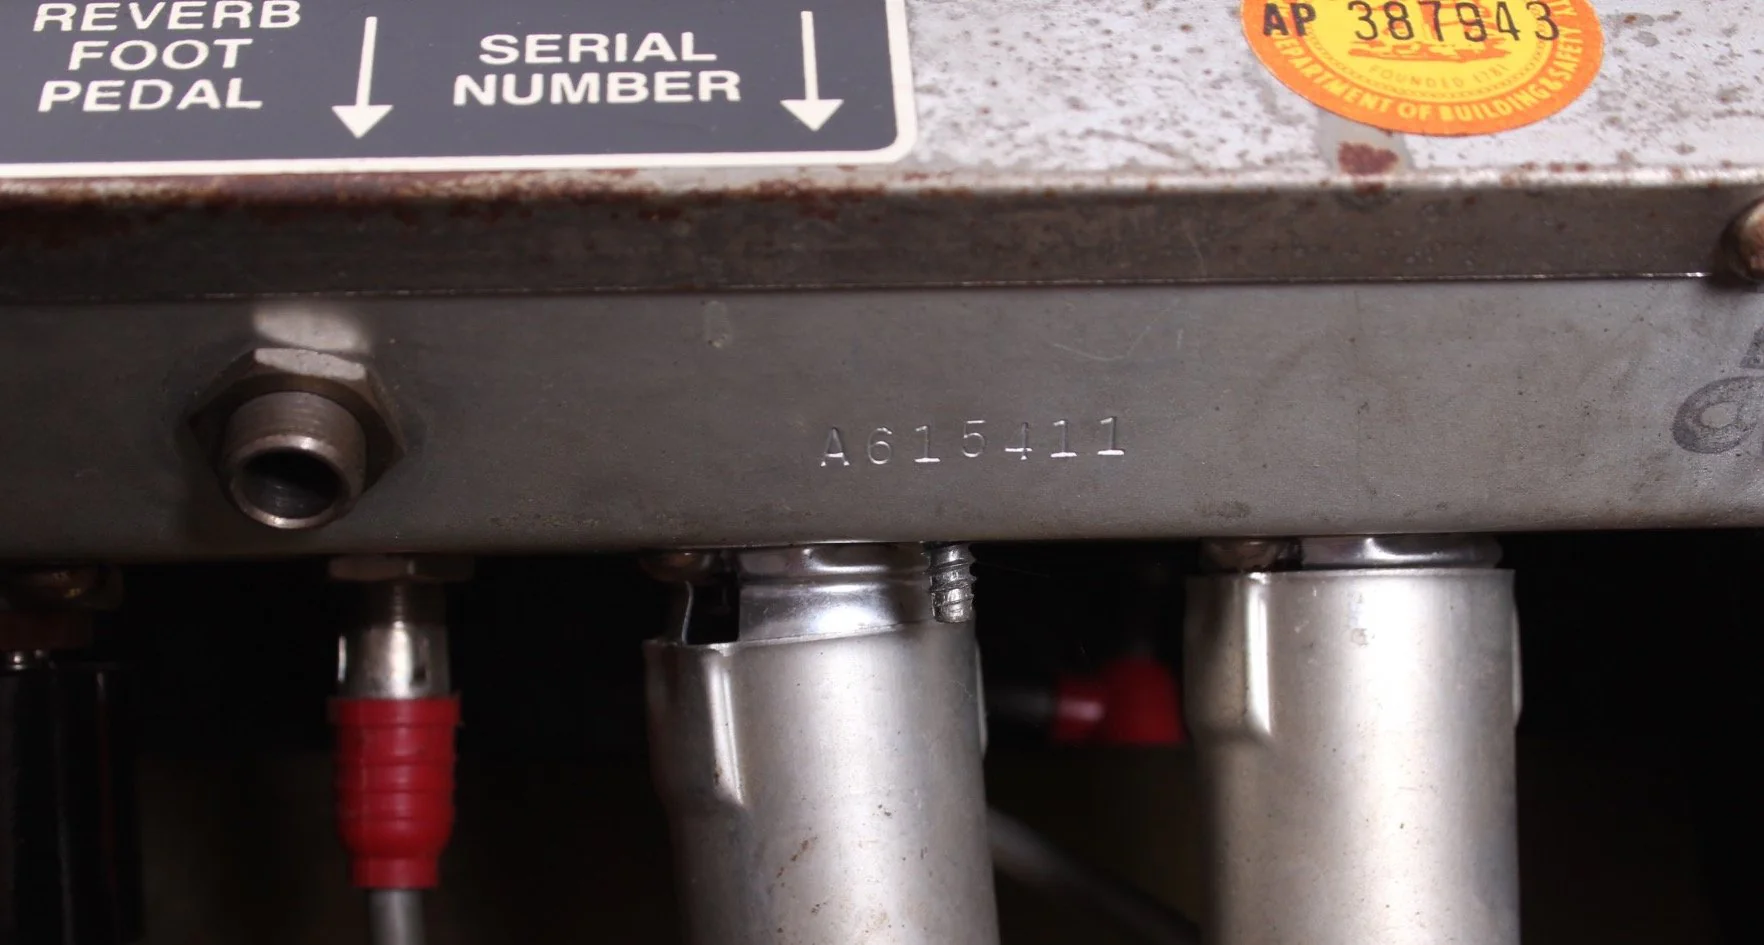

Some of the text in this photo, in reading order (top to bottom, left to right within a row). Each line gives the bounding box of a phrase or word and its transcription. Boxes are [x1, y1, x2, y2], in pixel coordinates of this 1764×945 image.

[33, 0, 300, 32] REVERB
[1263, 2, 1316, 36] AP
[1347, 0, 1559, 41] 387943
[68, 38, 253, 71] FOOT
[479, 31, 717, 65] SERIAL
[453, 70, 741, 106] NUMBER
[1368, 64, 1464, 89] FOUNDED
[38, 78, 263, 112] PEDAL
[1397, 101, 1432, 122] OF
[820, 415, 1125, 468] A615411
